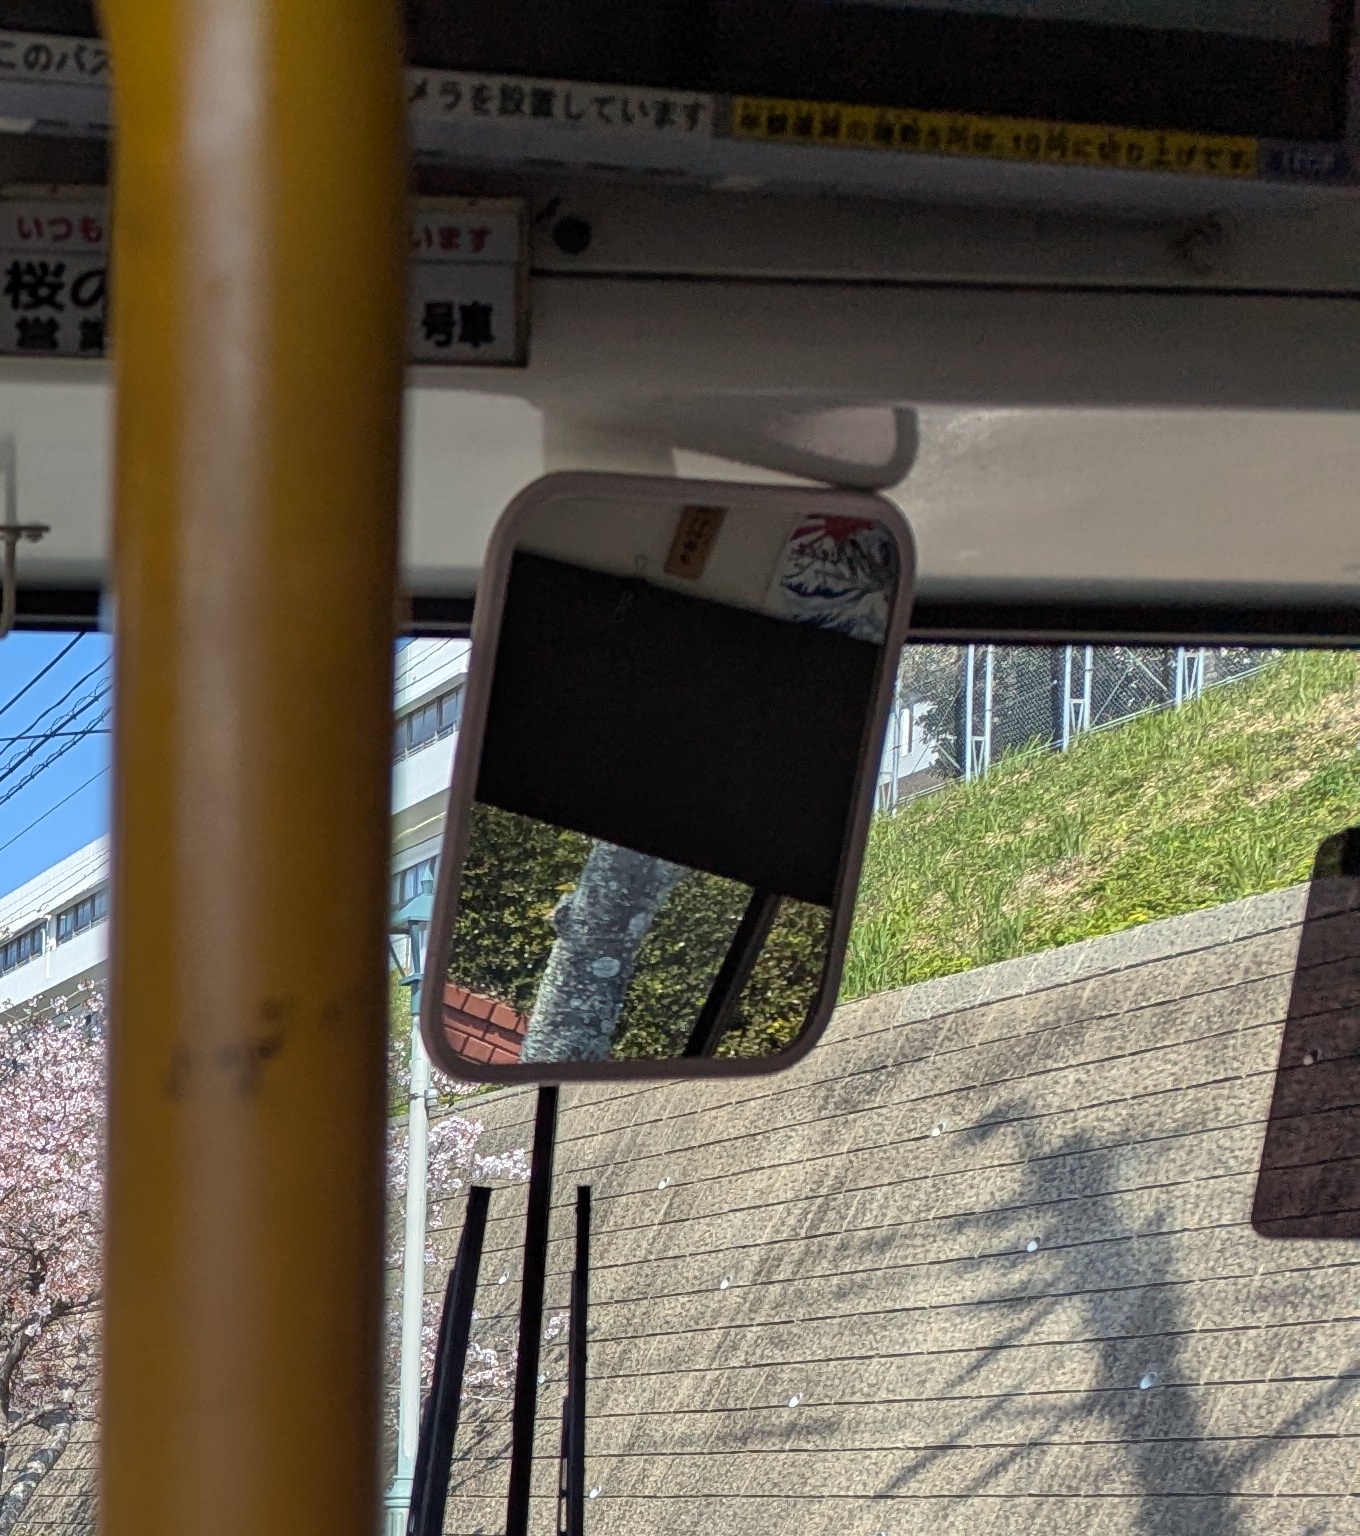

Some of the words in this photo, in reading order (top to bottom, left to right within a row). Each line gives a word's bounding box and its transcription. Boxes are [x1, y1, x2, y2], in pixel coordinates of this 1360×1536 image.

[17, 215, 104, 244] いつも
[3, 260, 106, 312] 桜の
[421, 301, 496, 348] 号車
